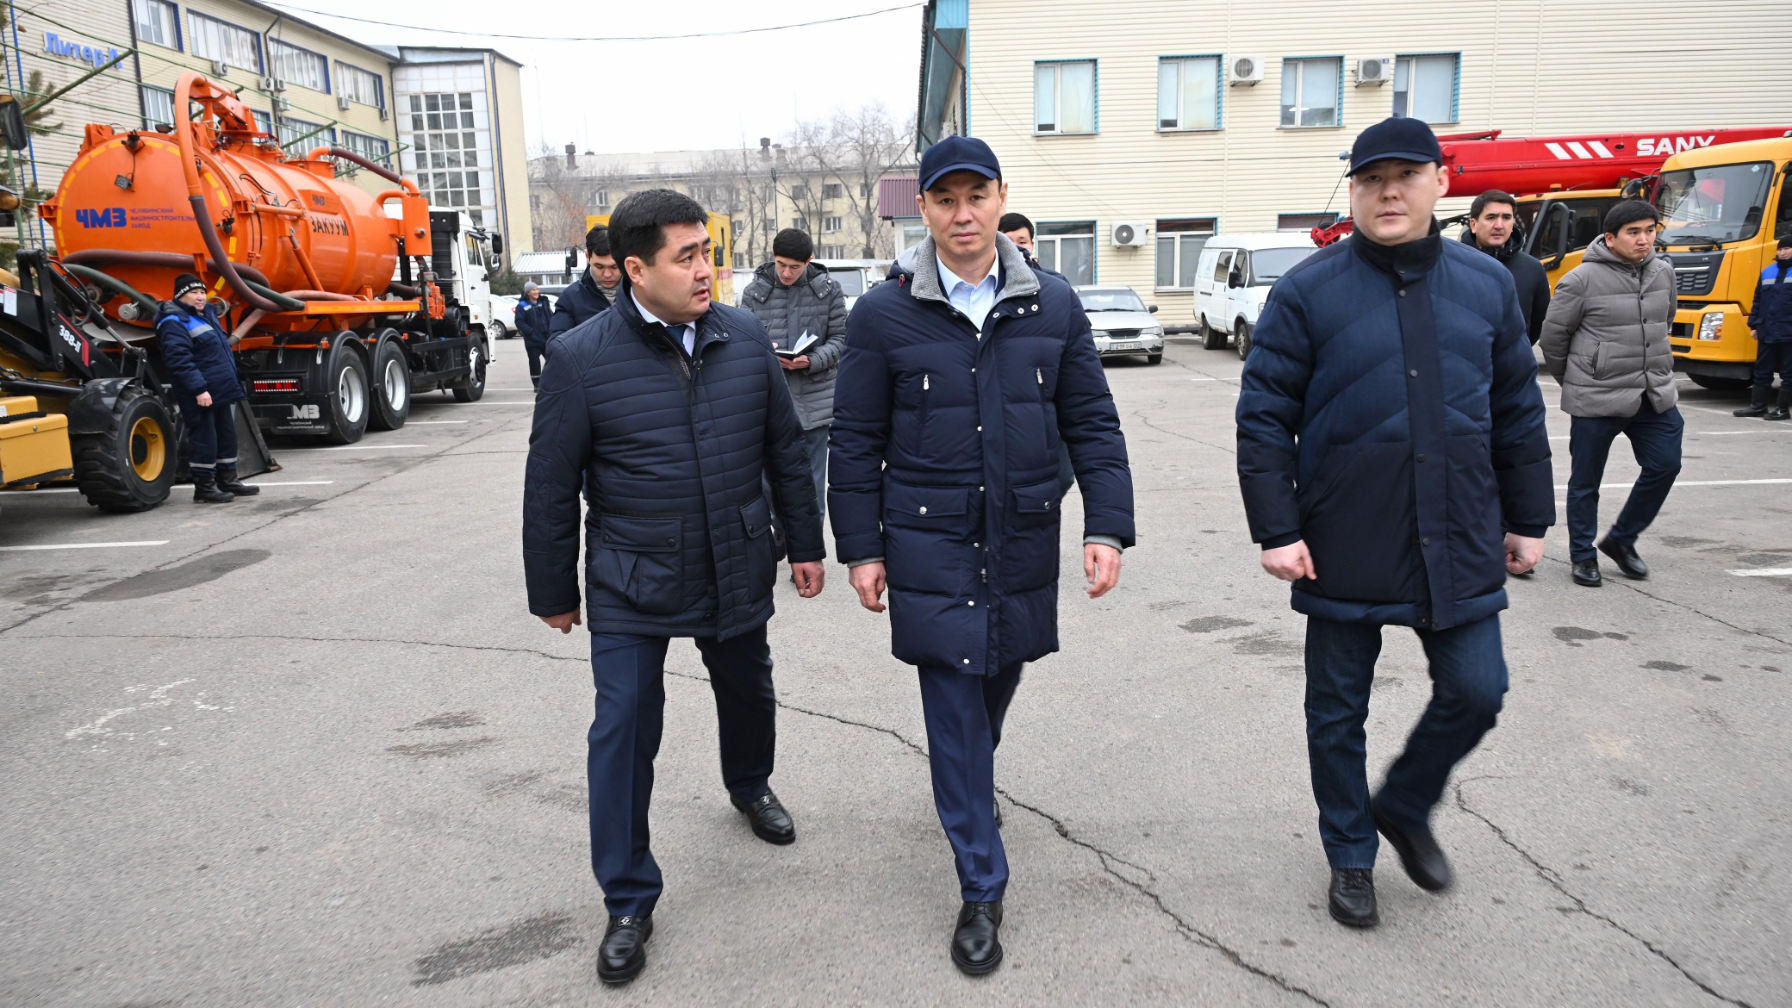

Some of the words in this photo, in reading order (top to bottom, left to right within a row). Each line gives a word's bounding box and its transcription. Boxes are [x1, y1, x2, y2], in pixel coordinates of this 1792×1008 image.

[43, 31, 105, 69] Литер
[1636, 135, 1716, 157] SANY
[75, 207, 128, 229] ЧМЗ
[130, 214, 197, 222] МАШИНОСТРОИТЕЛЬ
[287, 404, 320, 420] МЗ
